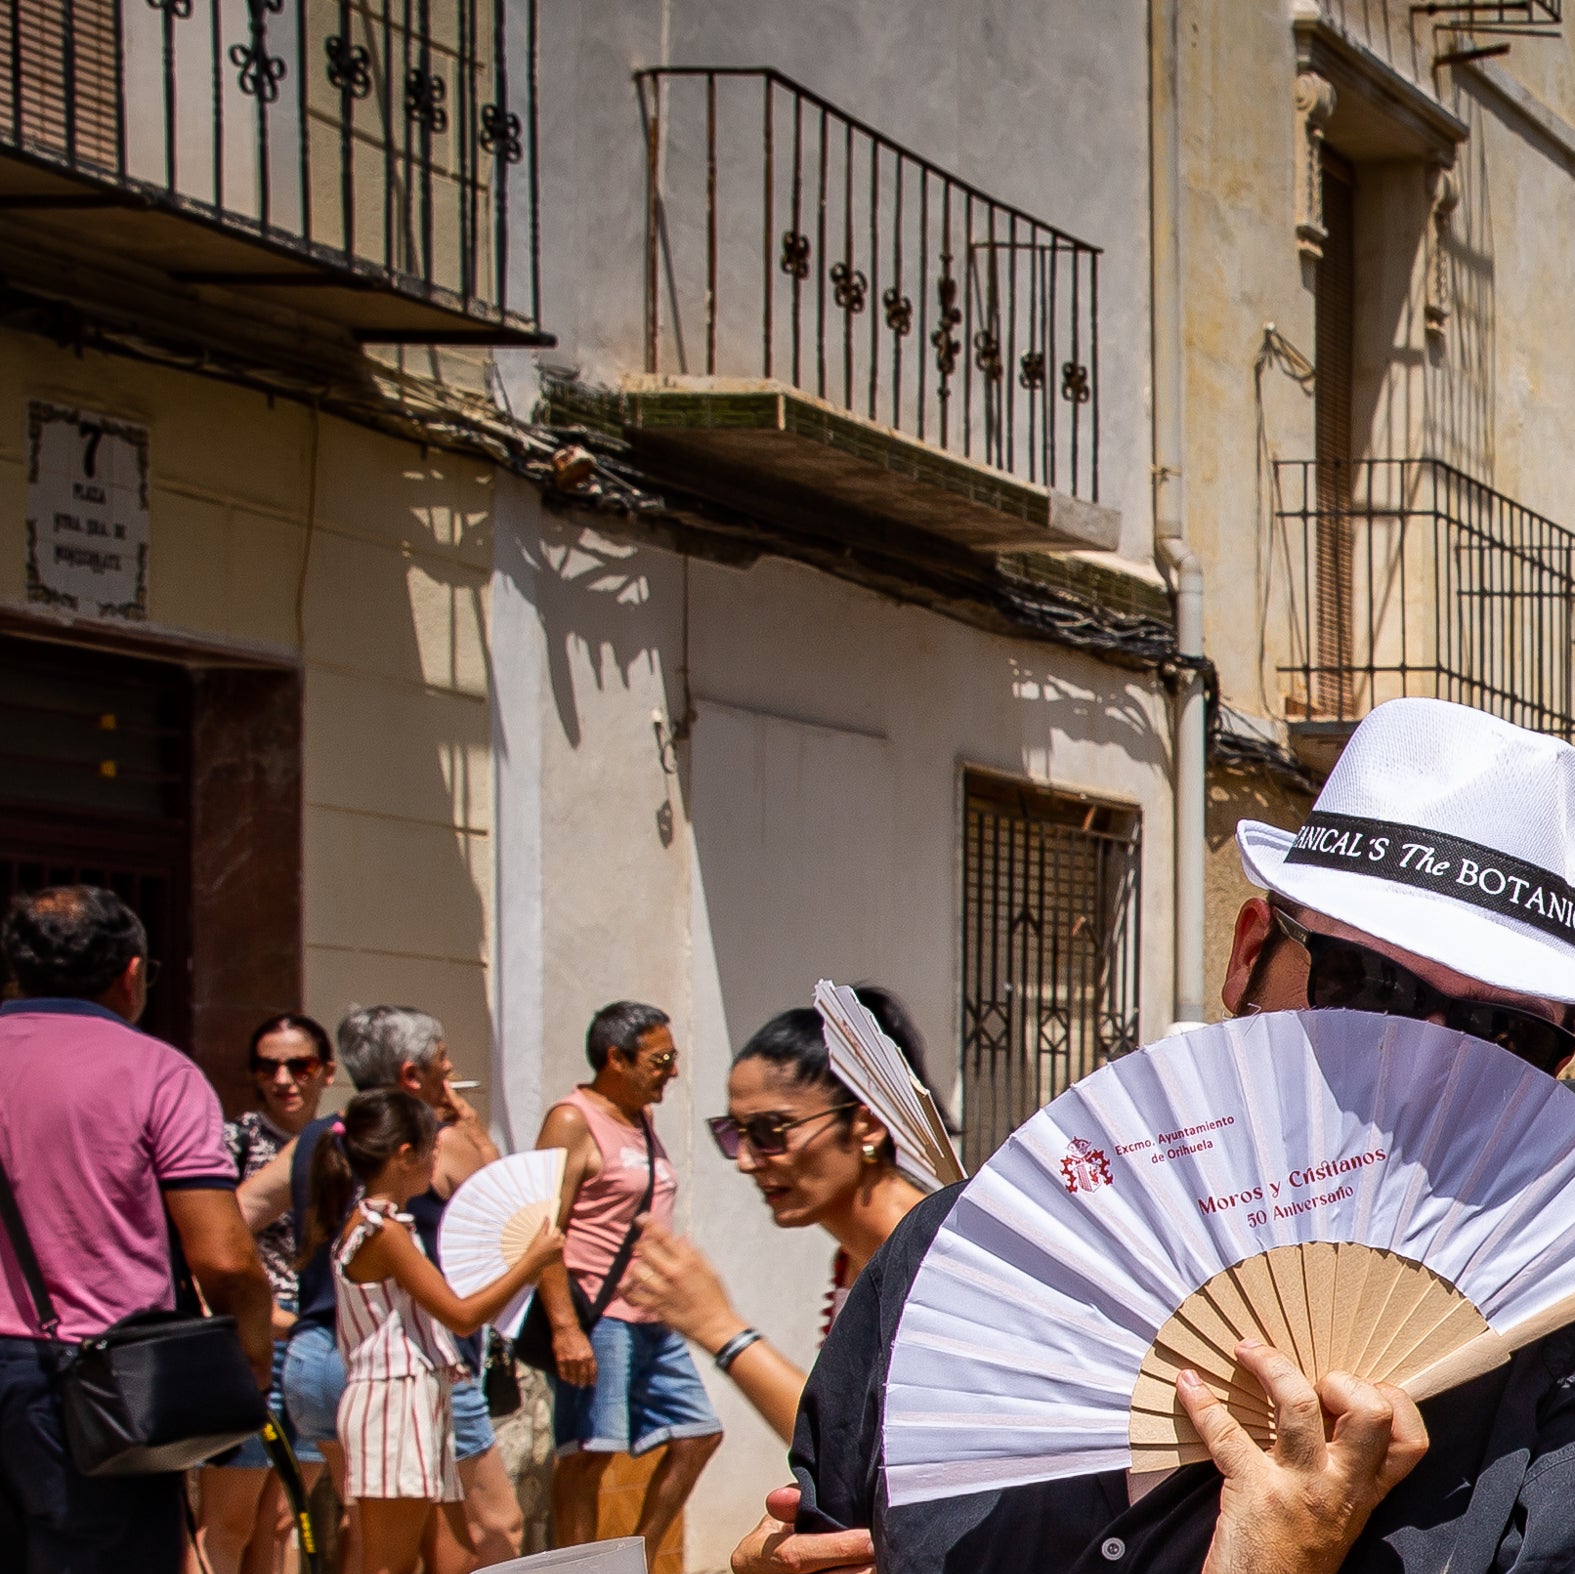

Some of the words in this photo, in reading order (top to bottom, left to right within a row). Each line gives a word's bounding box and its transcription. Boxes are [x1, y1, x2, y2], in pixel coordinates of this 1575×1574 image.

[79, 420, 104, 478] 7
[1399, 843, 1449, 877] The
[1115, 1138, 1156, 1157] Excmo.
[1157, 1114, 1236, 1147] Ayuntamiento
[1151, 1152, 1164, 1165] de
[1167, 1138, 1215, 1161] Orihuela
[1197, 1185, 1264, 1217] Moros
[1270, 1179, 1283, 1199] y
[1288, 1146, 1388, 1189] Cristianos
[1247, 1210, 1268, 1229] 50
[1272, 1184, 1355, 1222] Aniversario
